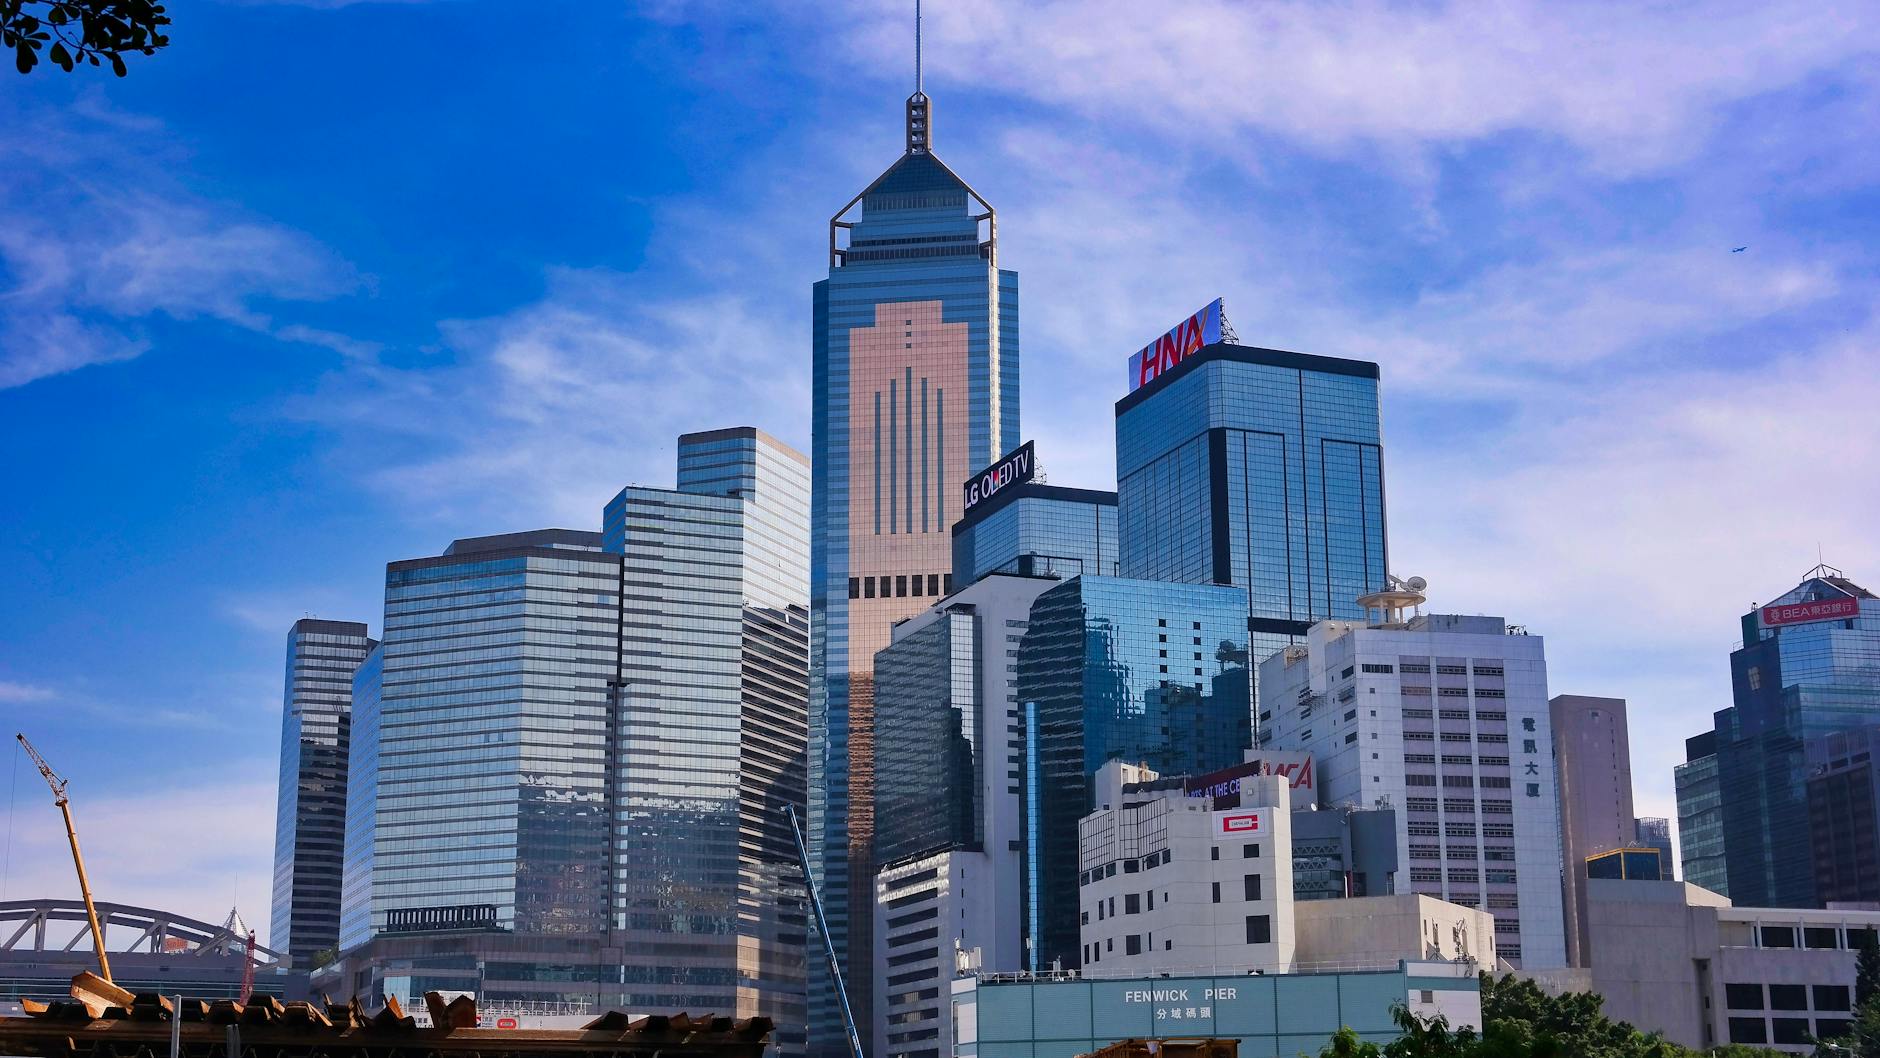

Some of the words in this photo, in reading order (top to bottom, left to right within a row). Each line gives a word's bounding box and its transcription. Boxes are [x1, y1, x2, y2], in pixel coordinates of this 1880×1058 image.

[1139, 306, 1208, 387] HNA
[964, 482, 979, 510] LG
[981, 463, 1013, 498] OLED
[1013, 449, 1029, 478] TV
[1783, 607, 1810, 619] BEA
[1204, 785, 1214, 798] AT
[1214, 781, 1228, 797] THE
[1125, 989, 1189, 1002] FENWICK
[1204, 987, 1237, 1000] PIER
[1156, 1006, 1211, 1019] 分域碼頭
